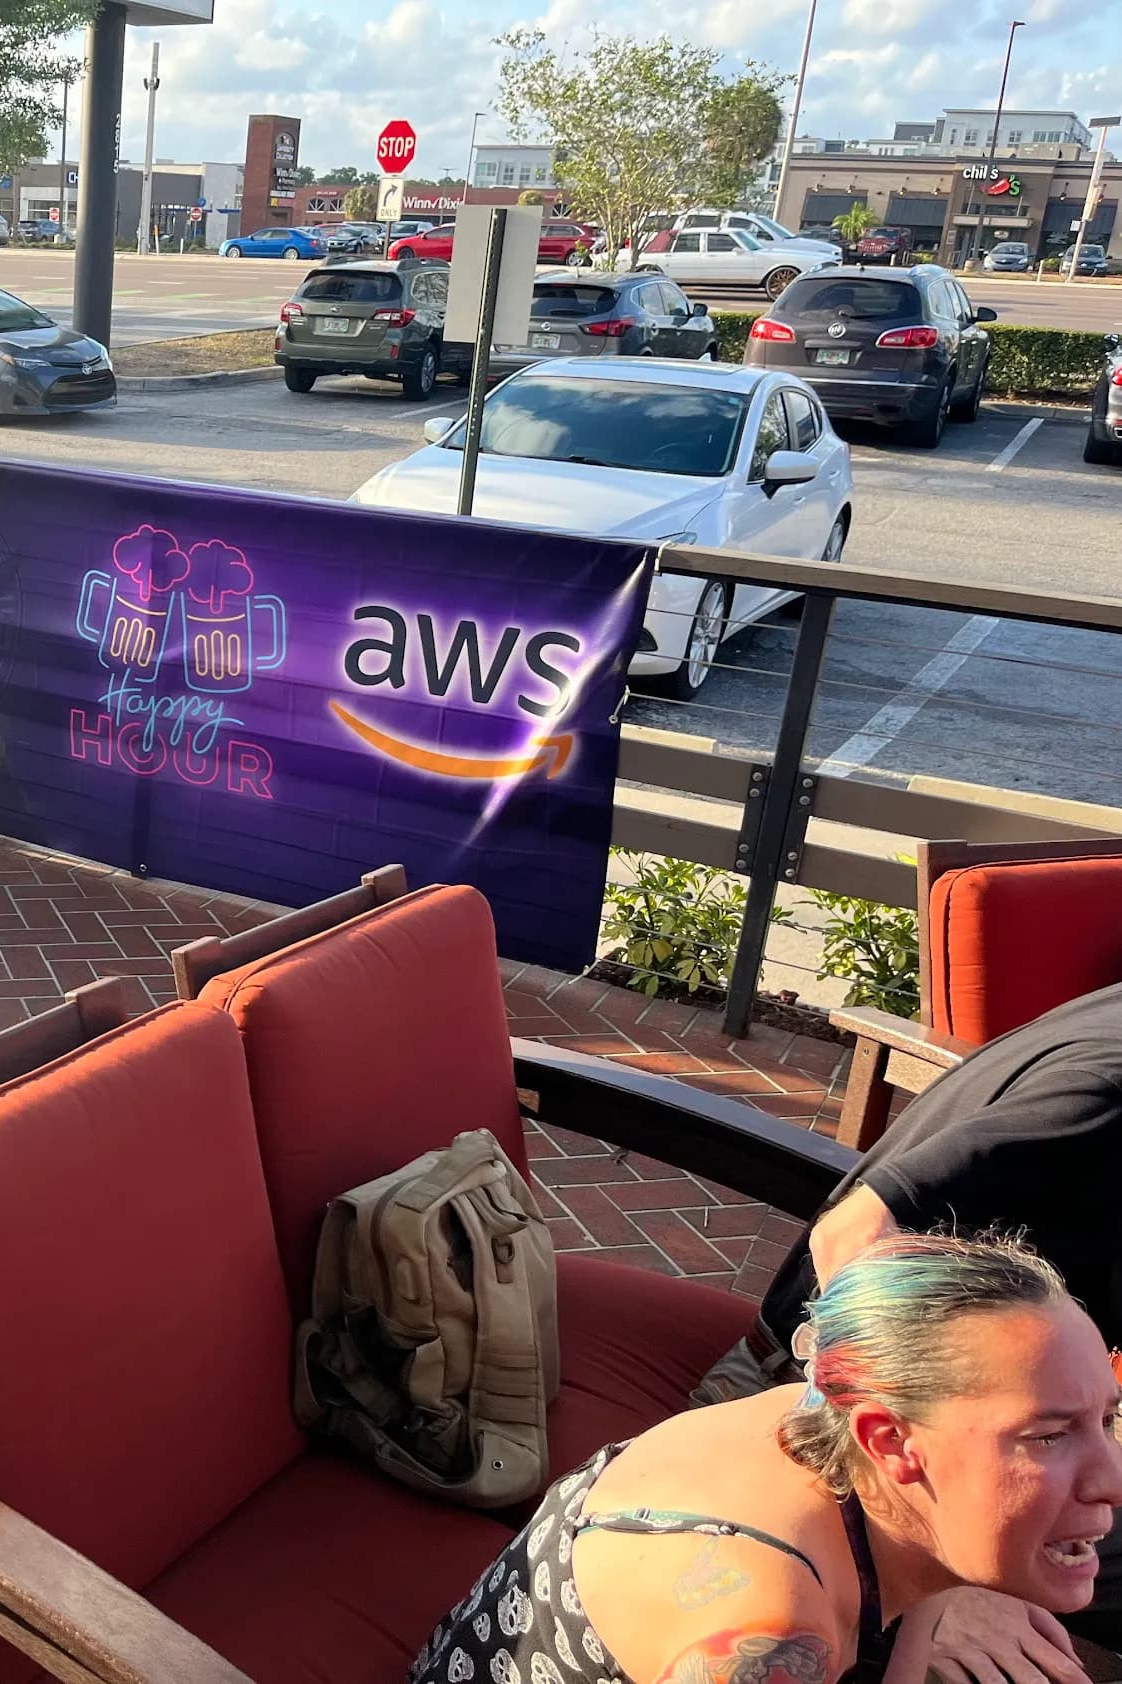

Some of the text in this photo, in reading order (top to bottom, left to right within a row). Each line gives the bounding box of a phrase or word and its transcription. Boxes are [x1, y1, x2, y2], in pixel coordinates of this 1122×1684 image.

[379, 136, 415, 158] STOP
[380, 207, 398, 217] ONLY
[344, 605, 581, 718] aws
[70, 708, 274, 800] HOUR
[97, 667, 245, 754] Happy
